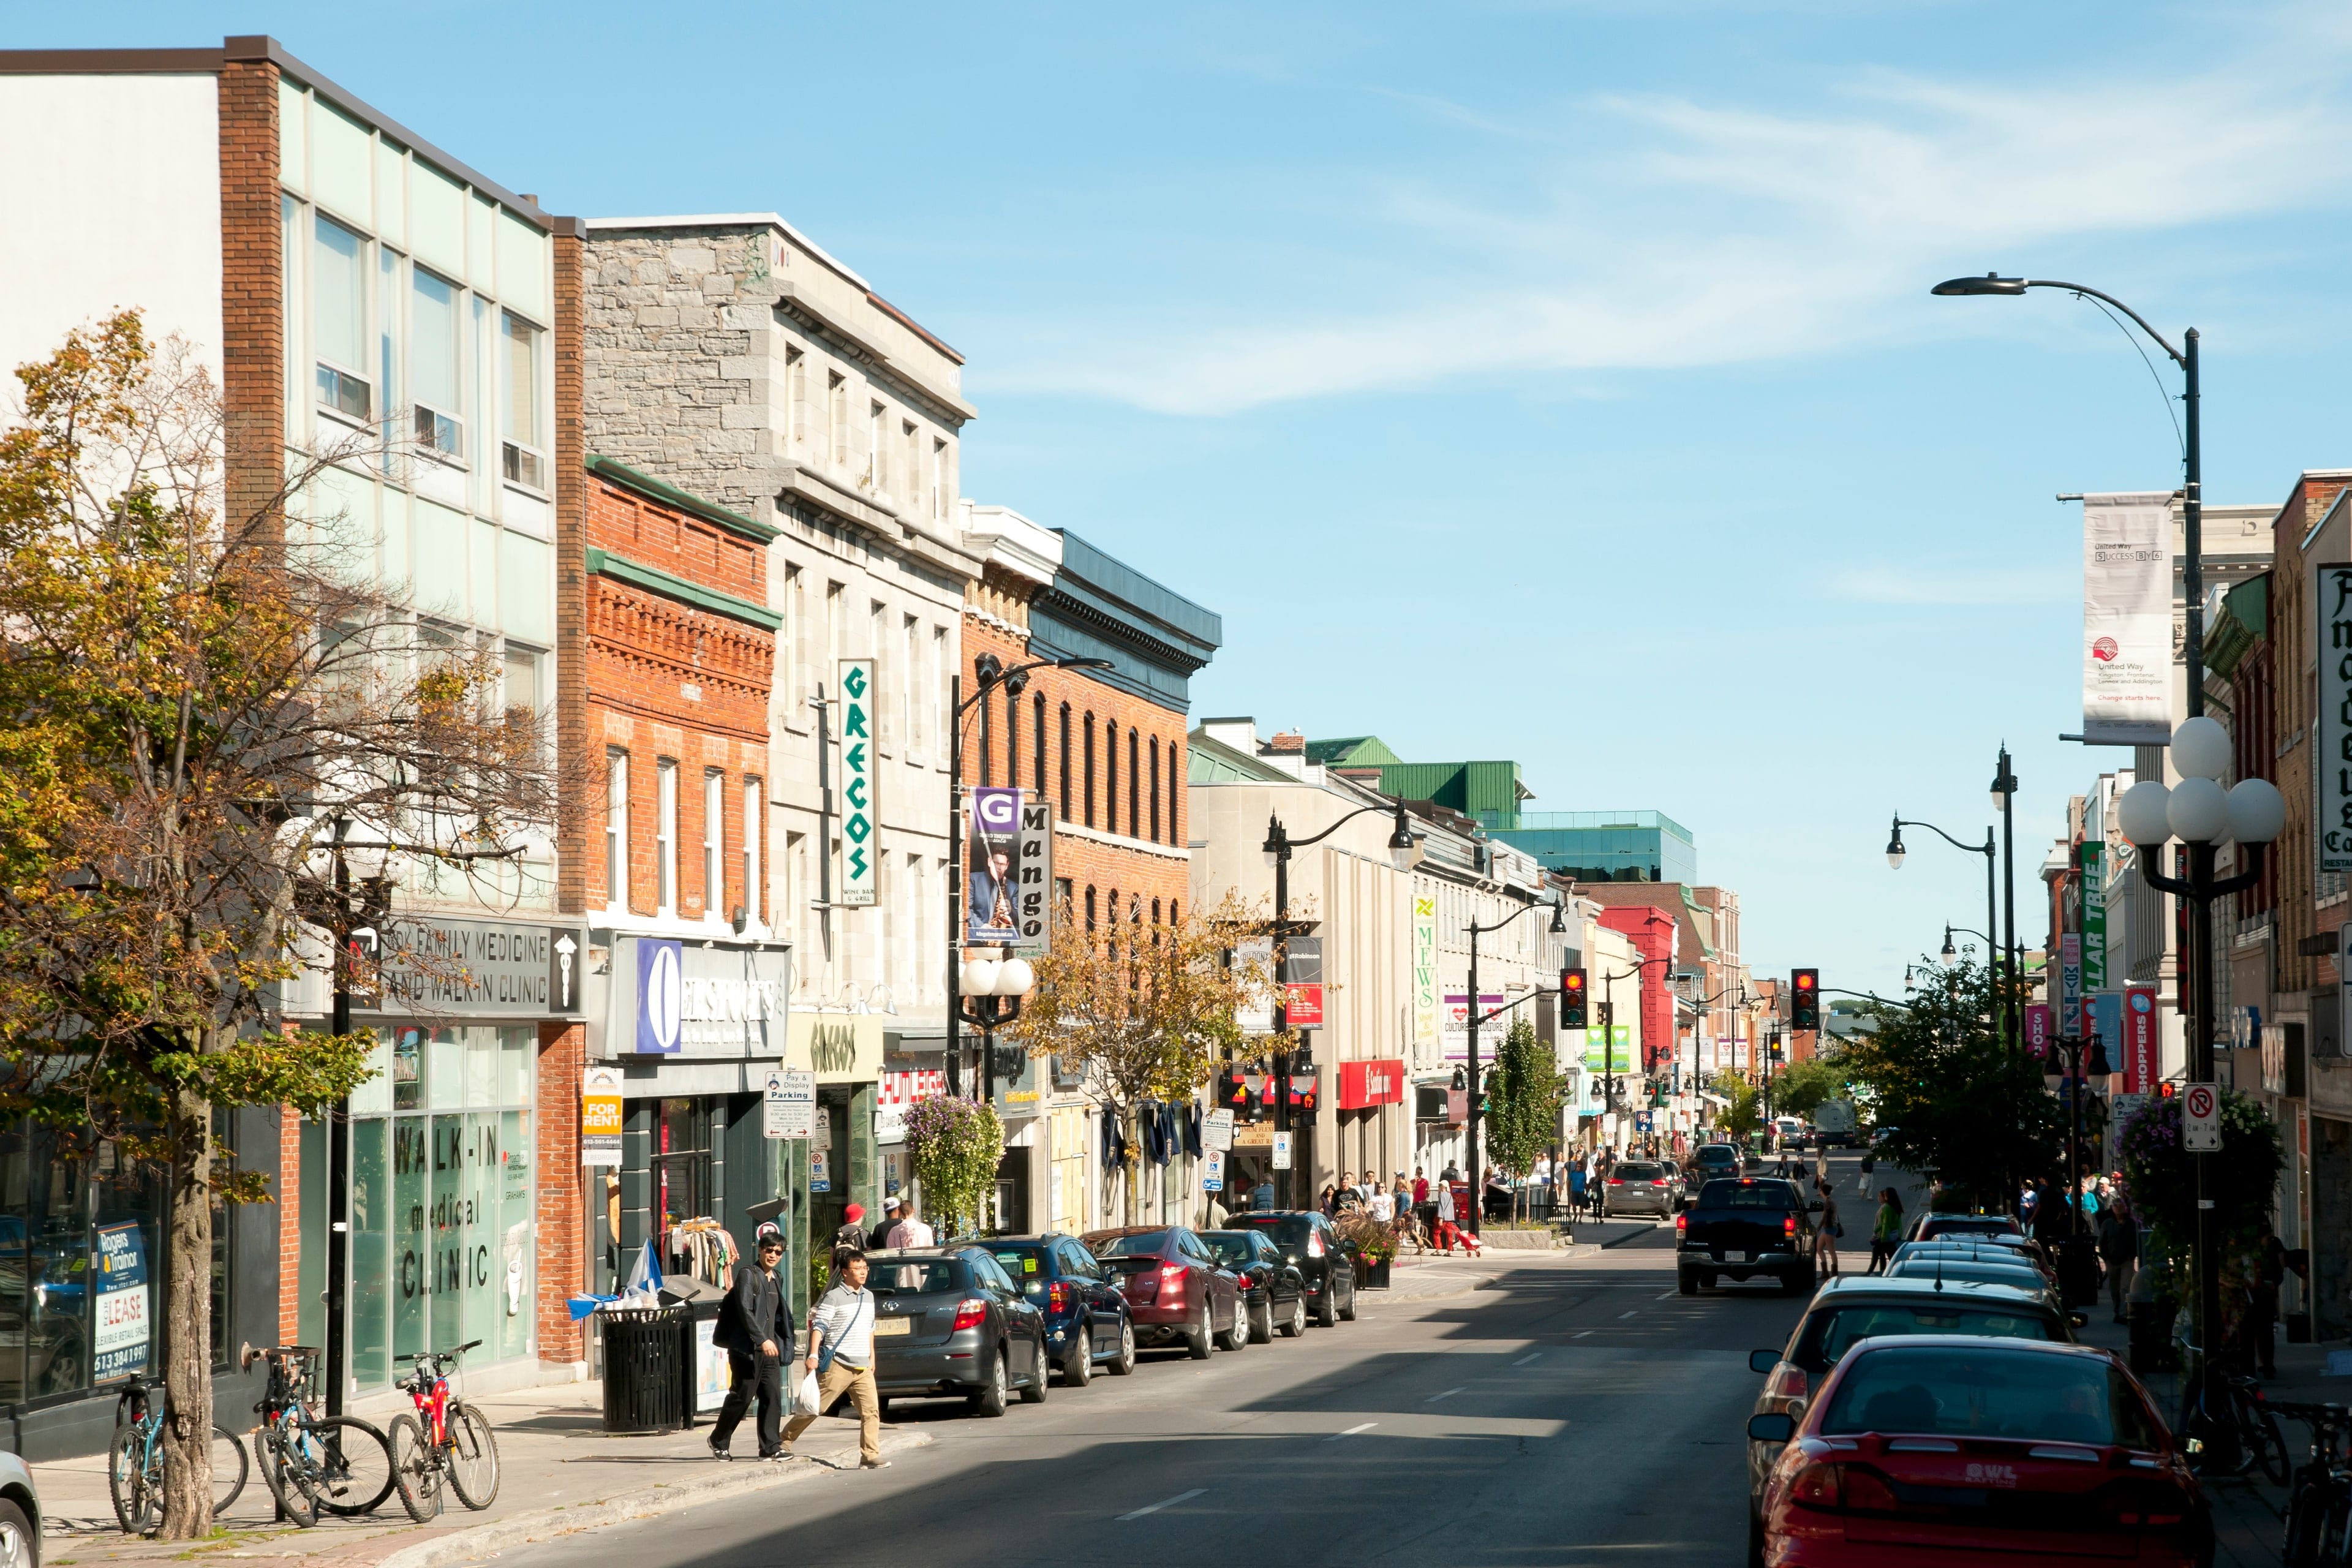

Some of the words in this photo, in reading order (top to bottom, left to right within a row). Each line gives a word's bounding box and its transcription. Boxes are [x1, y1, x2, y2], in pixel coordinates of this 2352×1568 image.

[2097, 552, 2135, 560] SUCCESS
[2127, 663, 2144, 671] Way
[843, 666, 872, 881] GRECOS
[980, 793, 1012, 823] G
[1022, 807, 1047, 937] Mango
[2086, 862, 2103, 922] TREE
[417, 929, 470, 960] FAMILY
[475, 930, 547, 963] MEDICINE
[1416, 926, 1436, 1008] MEWS
[388, 971, 424, 1000] AND
[431, 973, 473, 1002] WALK
[499, 974, 546, 1004] CLINIC
[2064, 966, 2079, 1005] MOVIE
[1419, 1012, 1434, 1023] Shop
[1445, 1022, 1469, 1032] CULTURE
[1479, 1022, 1503, 1032] CULTURE
[2136, 1014, 2148, 1094] SHOPPERS
[583, 1114, 620, 1126] RENT
[587, 1103, 617, 1115] FOR
[2187, 1123, 2191, 1132] 2
[2203, 1123, 2207, 1131] 7
[393, 1125, 496, 1175] WALK-IN
[412, 1190, 479, 1232] medical
[100, 1231, 129, 1254] Rogers
[104, 1254, 111, 1273] &
[111, 1250, 138, 1273] Trainor
[402, 1244, 488, 1299] CLINIC
[108, 1294, 141, 1325] LEASE
[118, 1329, 134, 1341] RETAIL
[135, 1324, 148, 1337] SPACE
[895, 1321, 907, 1330] 300
[1965, 1476, 2016, 1487] RAFTING
[1966, 1463, 2018, 1480] OWL
